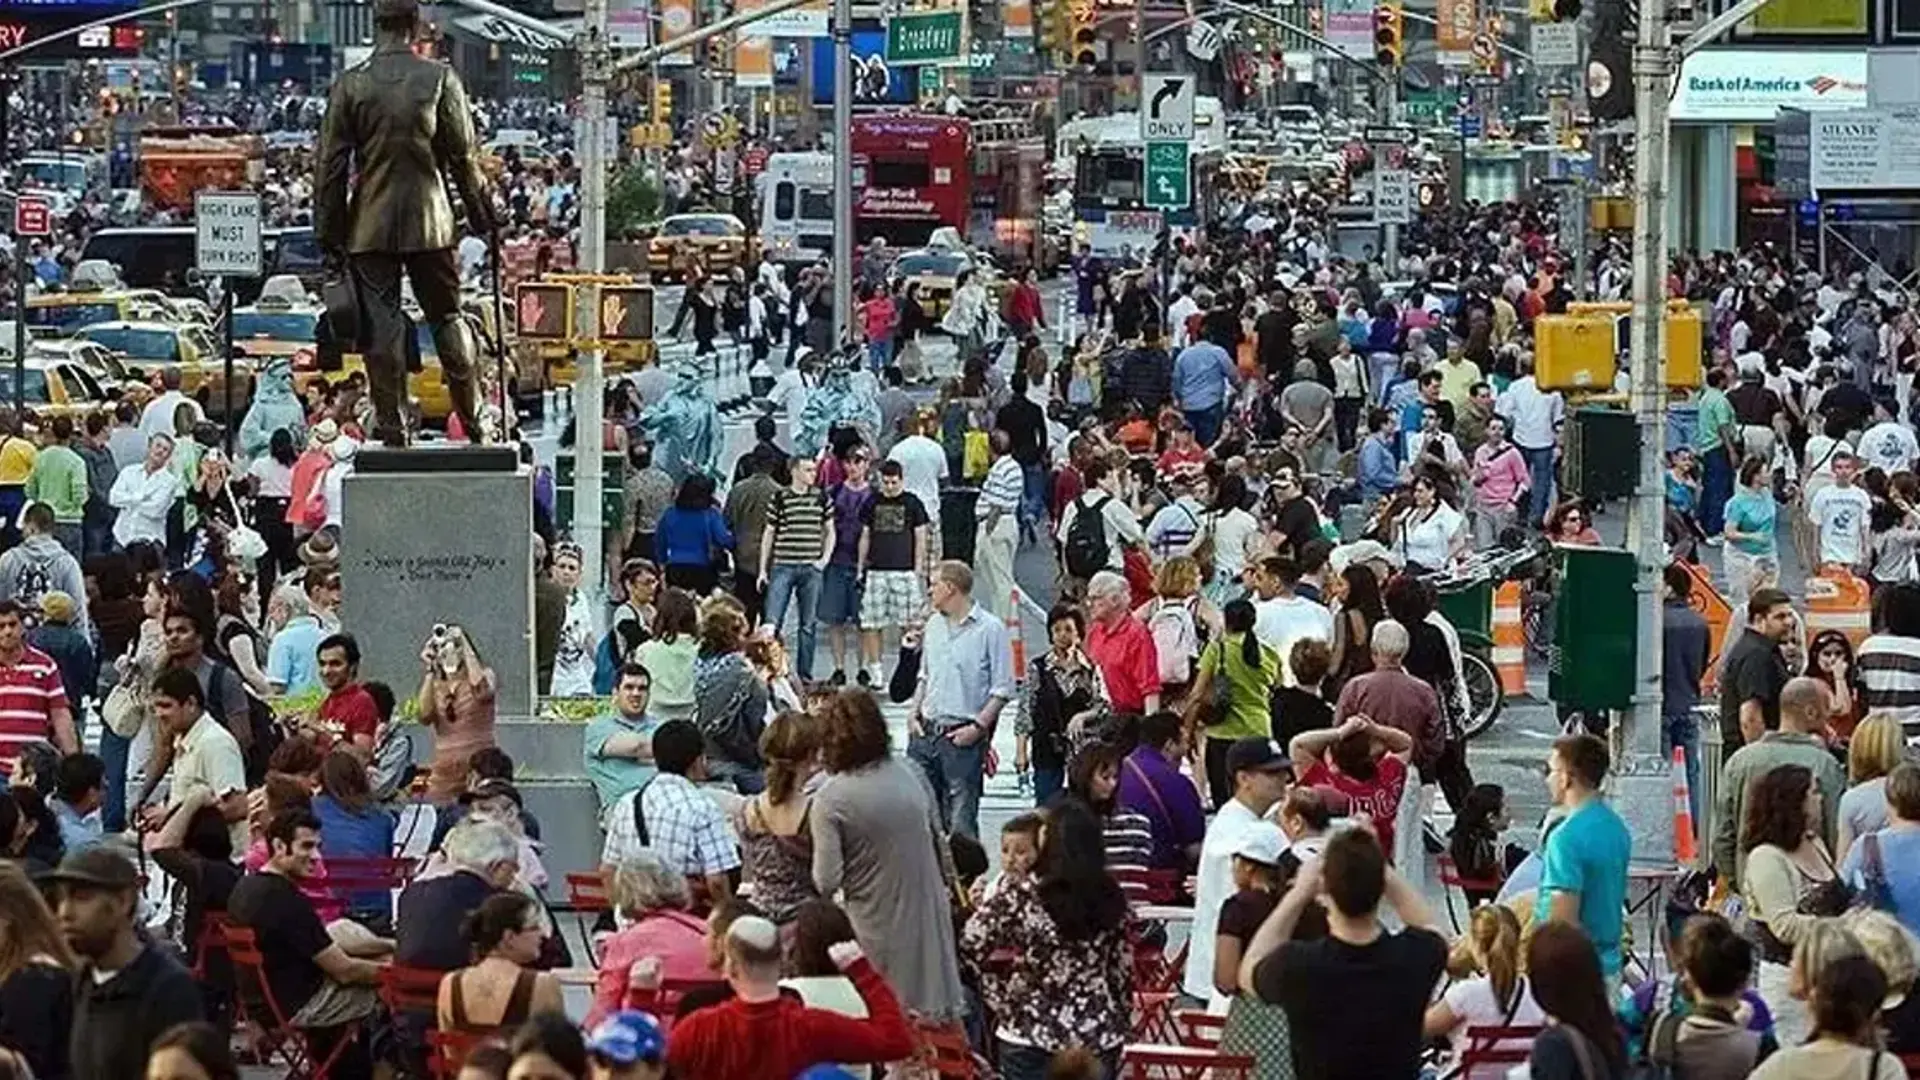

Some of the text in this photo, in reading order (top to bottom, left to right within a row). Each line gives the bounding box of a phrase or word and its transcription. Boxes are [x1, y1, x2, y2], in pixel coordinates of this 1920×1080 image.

[899, 25, 953, 53] Broadway
[1689, 76, 1801, 92] Bank of America
[1148, 122, 1186, 136] ONLY
[200, 202, 257, 217] RIGHT LANE
[211, 225, 243, 242] MUST
[200, 248, 257, 264] TURN RIGHT
